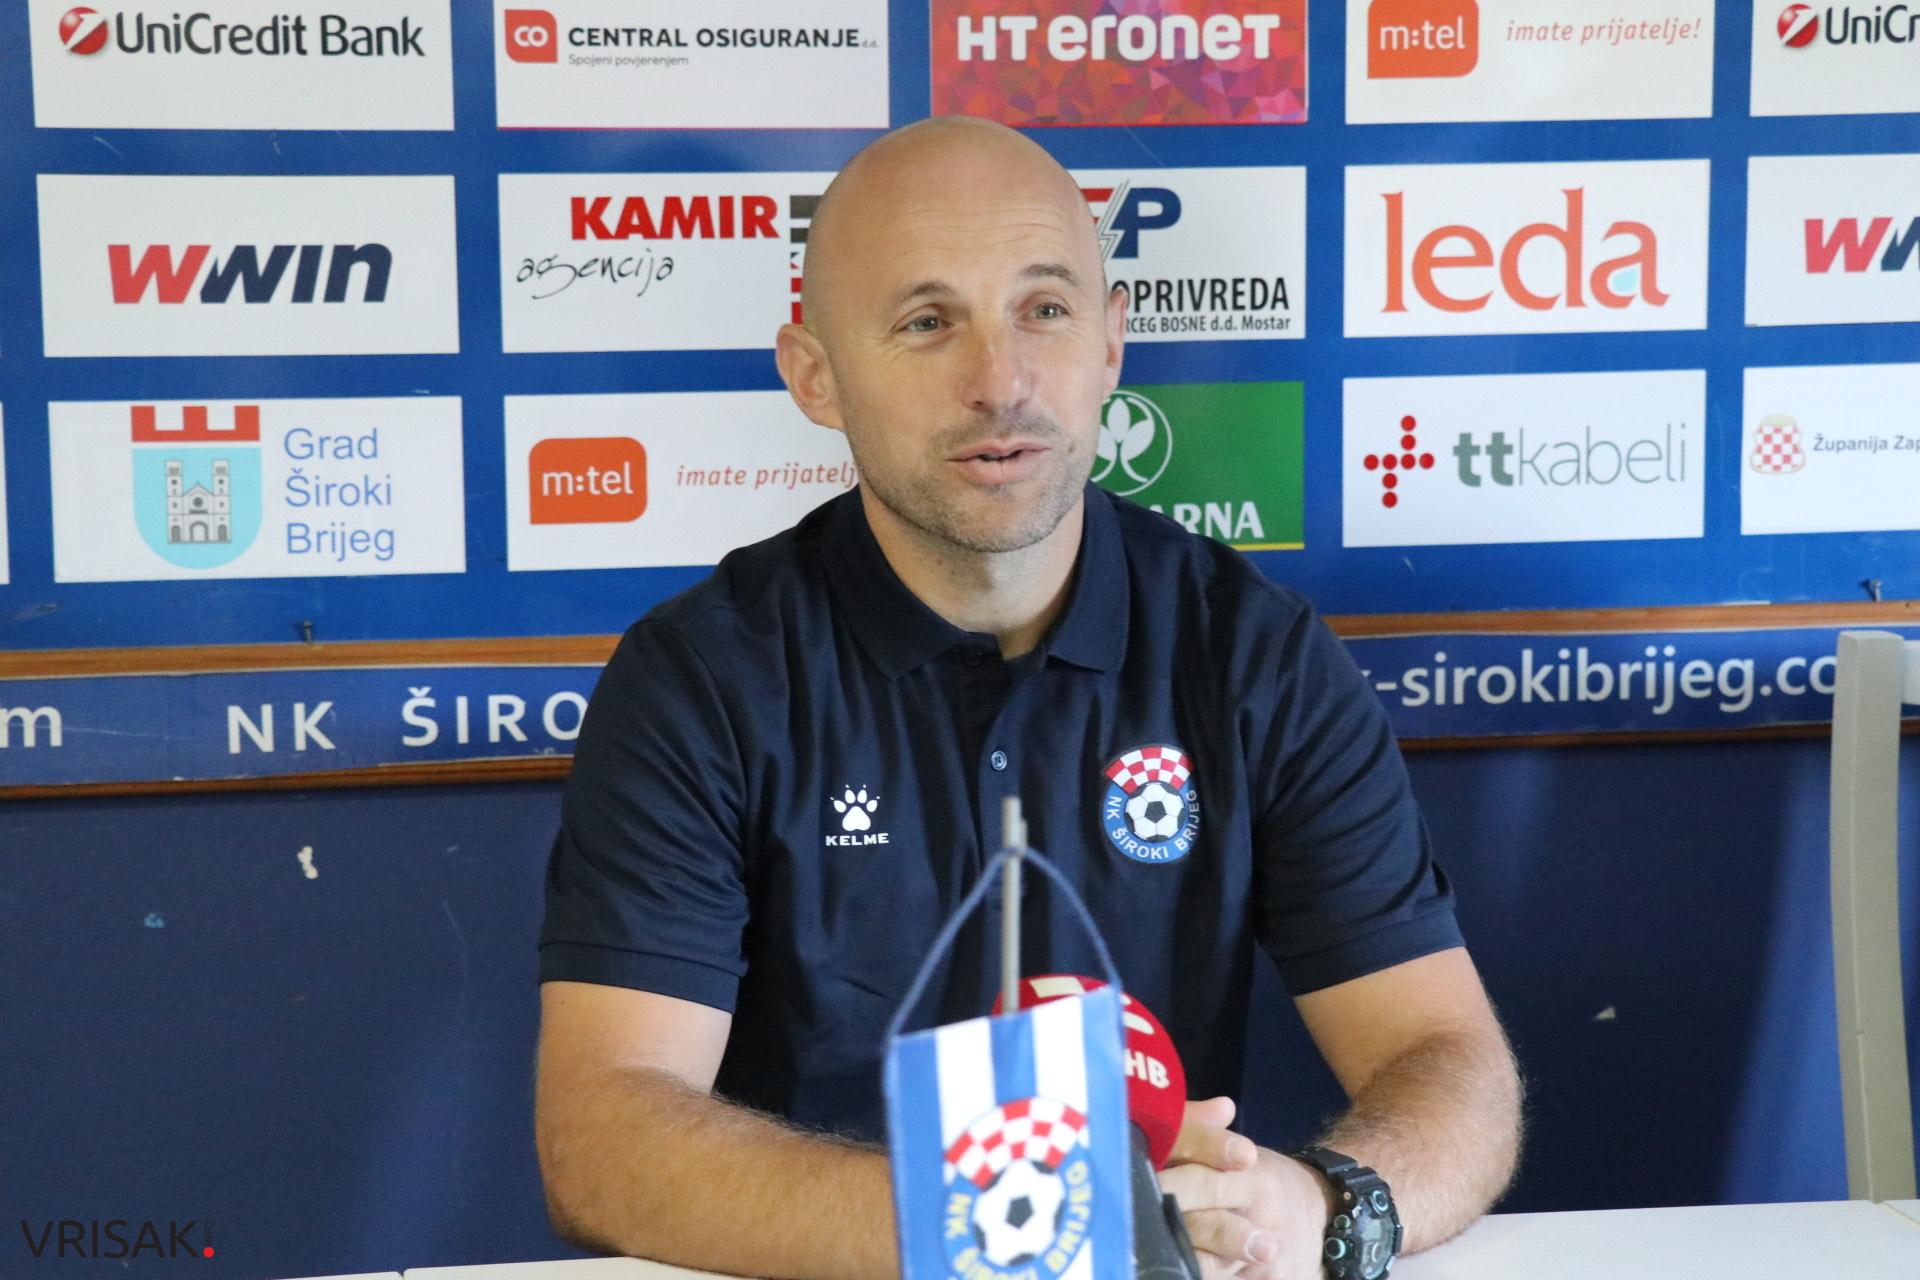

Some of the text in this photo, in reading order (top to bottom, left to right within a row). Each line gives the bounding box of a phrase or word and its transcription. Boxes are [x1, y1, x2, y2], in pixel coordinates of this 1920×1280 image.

[116, 13, 425, 56] UniCredit Bank
[568, 27, 688, 47] CENTRAL
[696, 28, 860, 48] OSIGURANJE
[957, 15, 1037, 61] HT
[1380, 21, 1466, 50] m:tel
[1506, 18, 1701, 46] imate prijatelje!
[568, 54, 689, 68] Spojeni povjerenjem
[570, 195, 781, 241] KAMIR
[1379, 187, 1670, 313] leda
[516, 247, 675, 300] agencija
[1161, 315, 1206, 332] BOSNE
[1210, 315, 1238, 331] d.d.
[1241, 315, 1291, 331] Mostar
[284, 428, 378, 460] Grad
[1453, 423, 1686, 487] ttkabeli
[1813, 432, 1889, 455] Županija
[285, 468, 392, 507] Široki
[543, 461, 634, 496] m:tel
[677, 465, 747, 486] imate
[286, 523, 396, 562] Brijeg
[1361, 646, 1837, 715] -sirokibrijeg.co
[228, 702, 336, 754] NK
[825, 833, 890, 847] KELME
[1106, 790, 1200, 860] NK ŠIROKI BRIJEG
